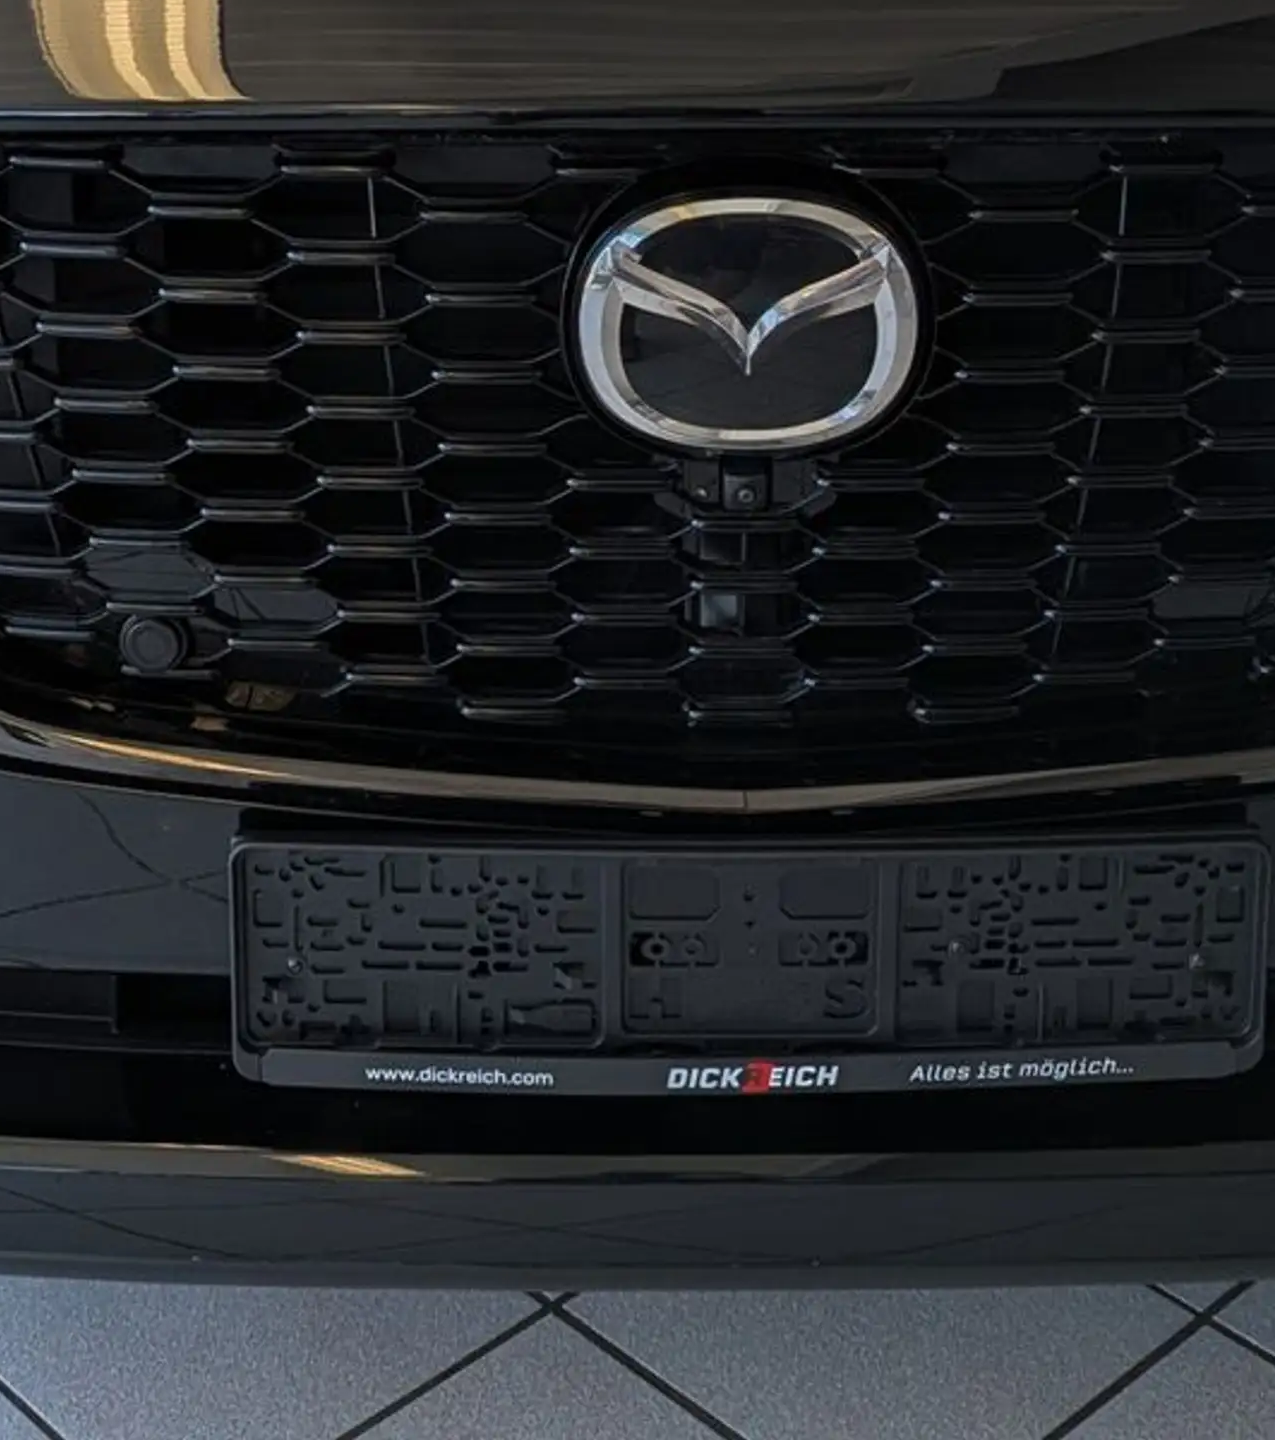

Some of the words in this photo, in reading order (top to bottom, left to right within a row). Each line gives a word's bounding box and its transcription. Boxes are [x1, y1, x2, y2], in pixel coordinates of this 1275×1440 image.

[365, 1066, 554, 1087] www.dickreich.com
[666, 1059, 839, 1093] DICKREICH
[909, 1063, 971, 1082] Alles
[977, 1061, 1013, 1080] ist
[1018, 1057, 1134, 1080] möglich...
